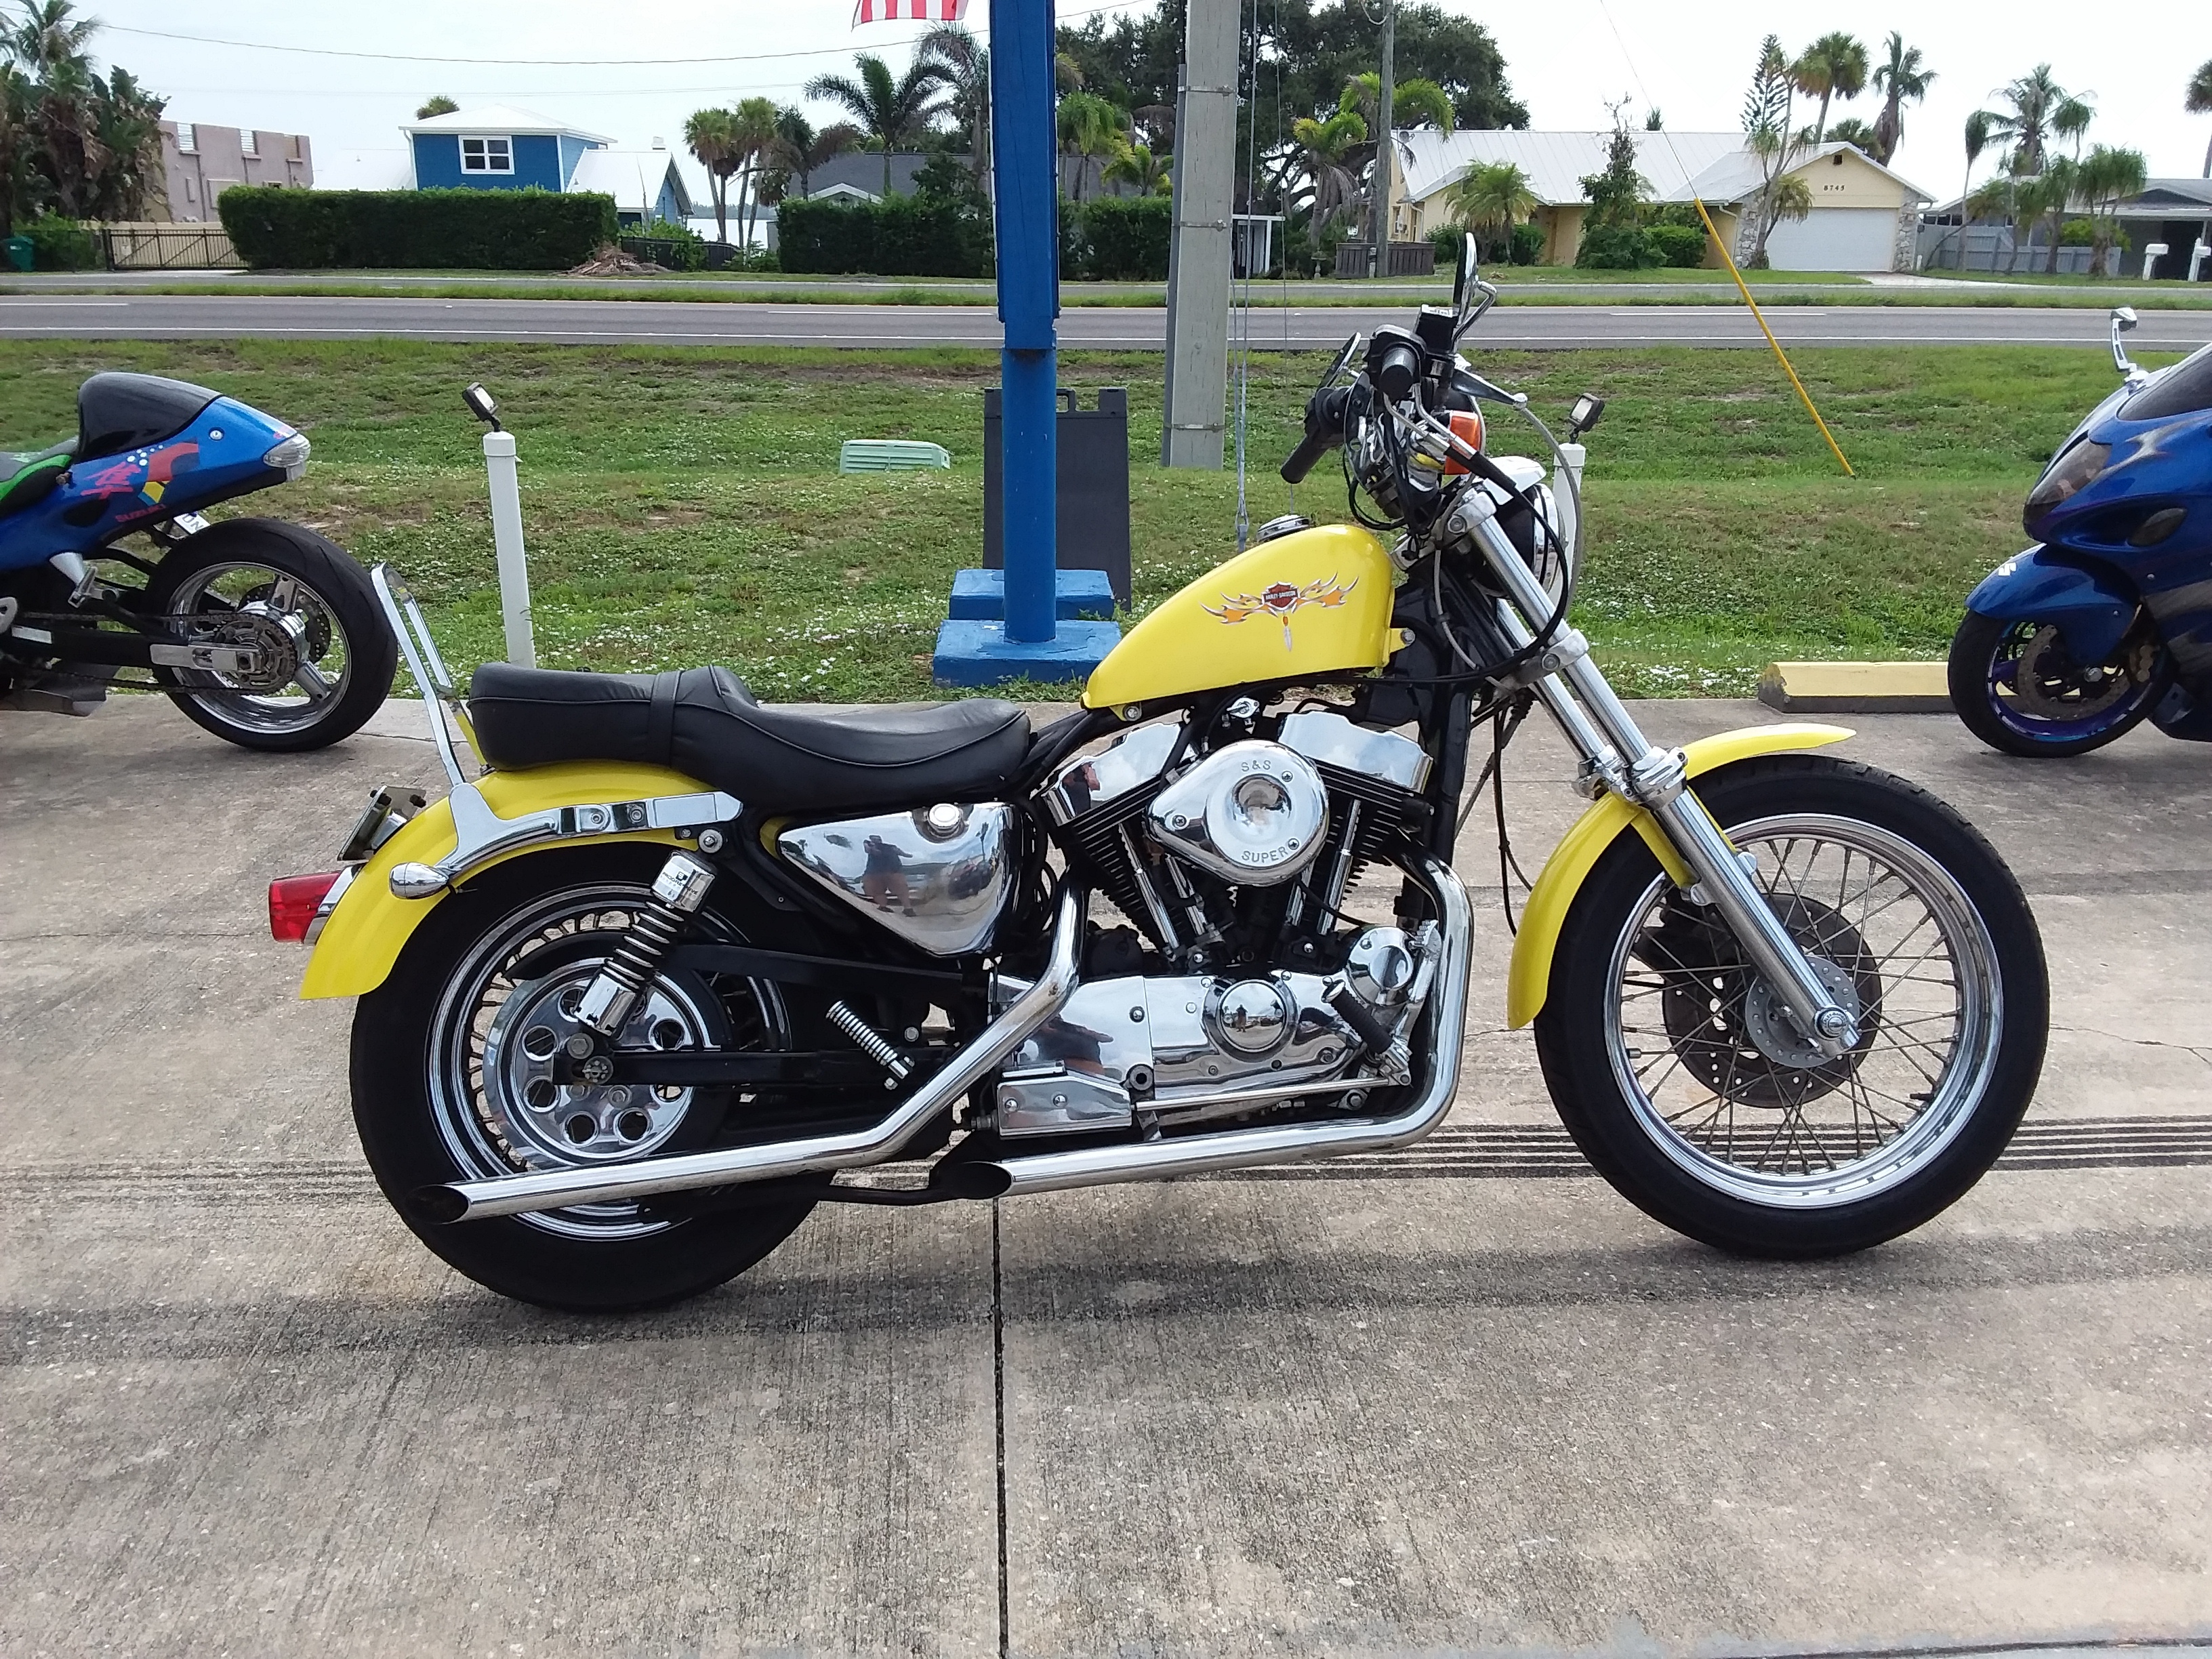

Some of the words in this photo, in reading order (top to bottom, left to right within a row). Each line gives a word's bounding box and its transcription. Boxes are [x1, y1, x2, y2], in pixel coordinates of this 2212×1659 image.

[1242, 760, 1271, 772] S&S
[1242, 846, 1288, 863] SUPER
[662, 872, 699, 895] PROGREIVE
